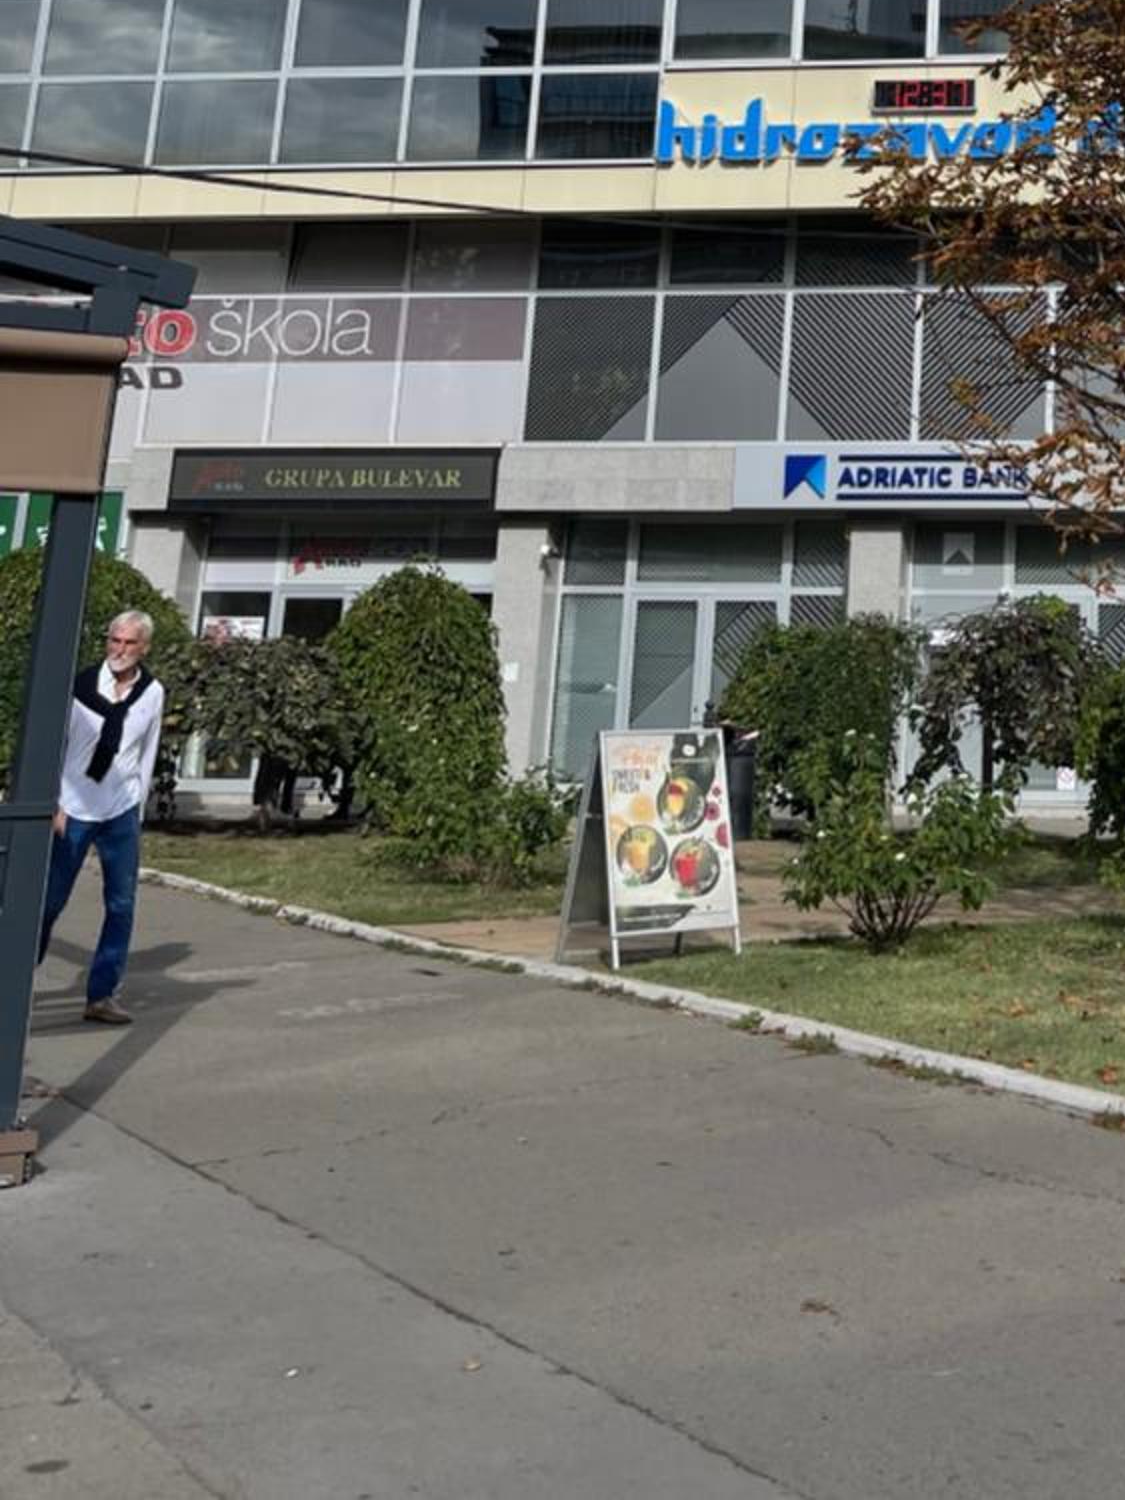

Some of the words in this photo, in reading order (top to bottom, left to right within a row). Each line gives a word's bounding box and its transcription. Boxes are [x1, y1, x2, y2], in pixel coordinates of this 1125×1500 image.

[206, 298, 374, 357] škola
[265, 468, 345, 488] GRUPA
[351, 468, 462, 488] BULEVAR
[838, 466, 953, 489] ADRIATIC
[962, 466, 1029, 489] BANK
